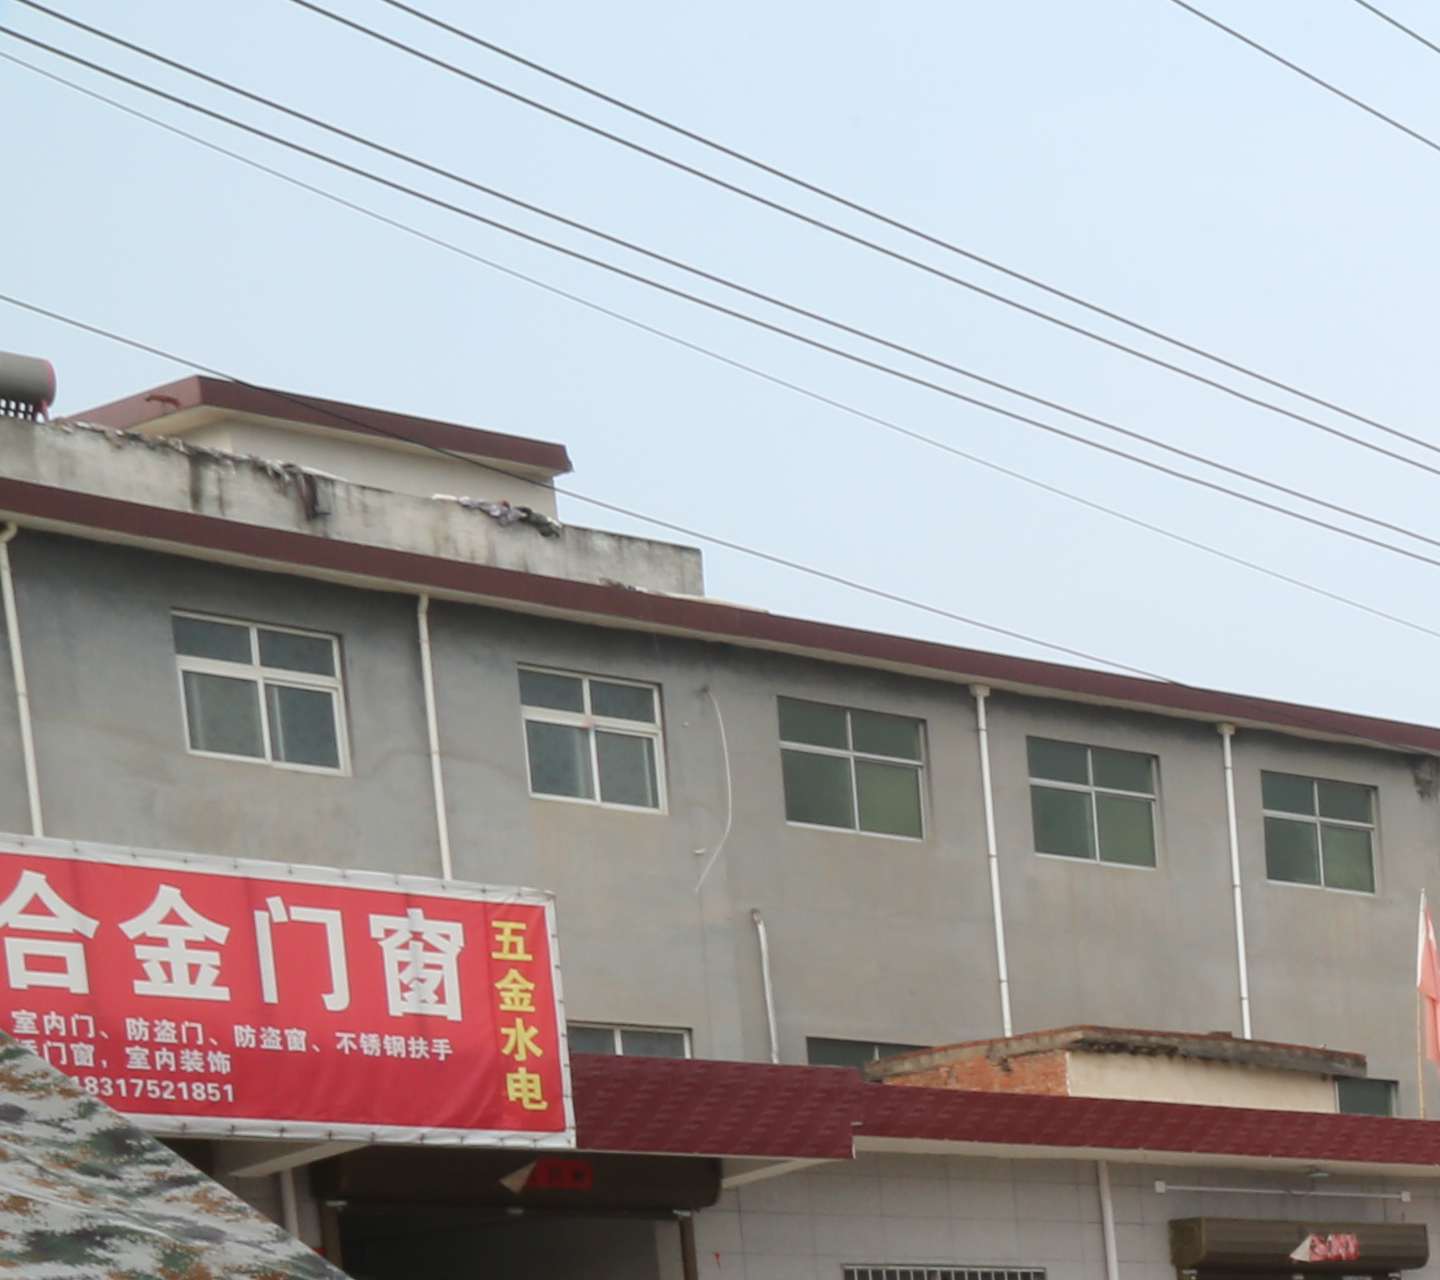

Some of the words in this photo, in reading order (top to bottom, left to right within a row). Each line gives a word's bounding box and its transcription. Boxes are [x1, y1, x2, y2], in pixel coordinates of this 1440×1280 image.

[0, 869, 465, 1022] 合金门窗
[491, 919, 549, 1110] 五金水电
[73, 1075, 235, 1102] 18317521851
